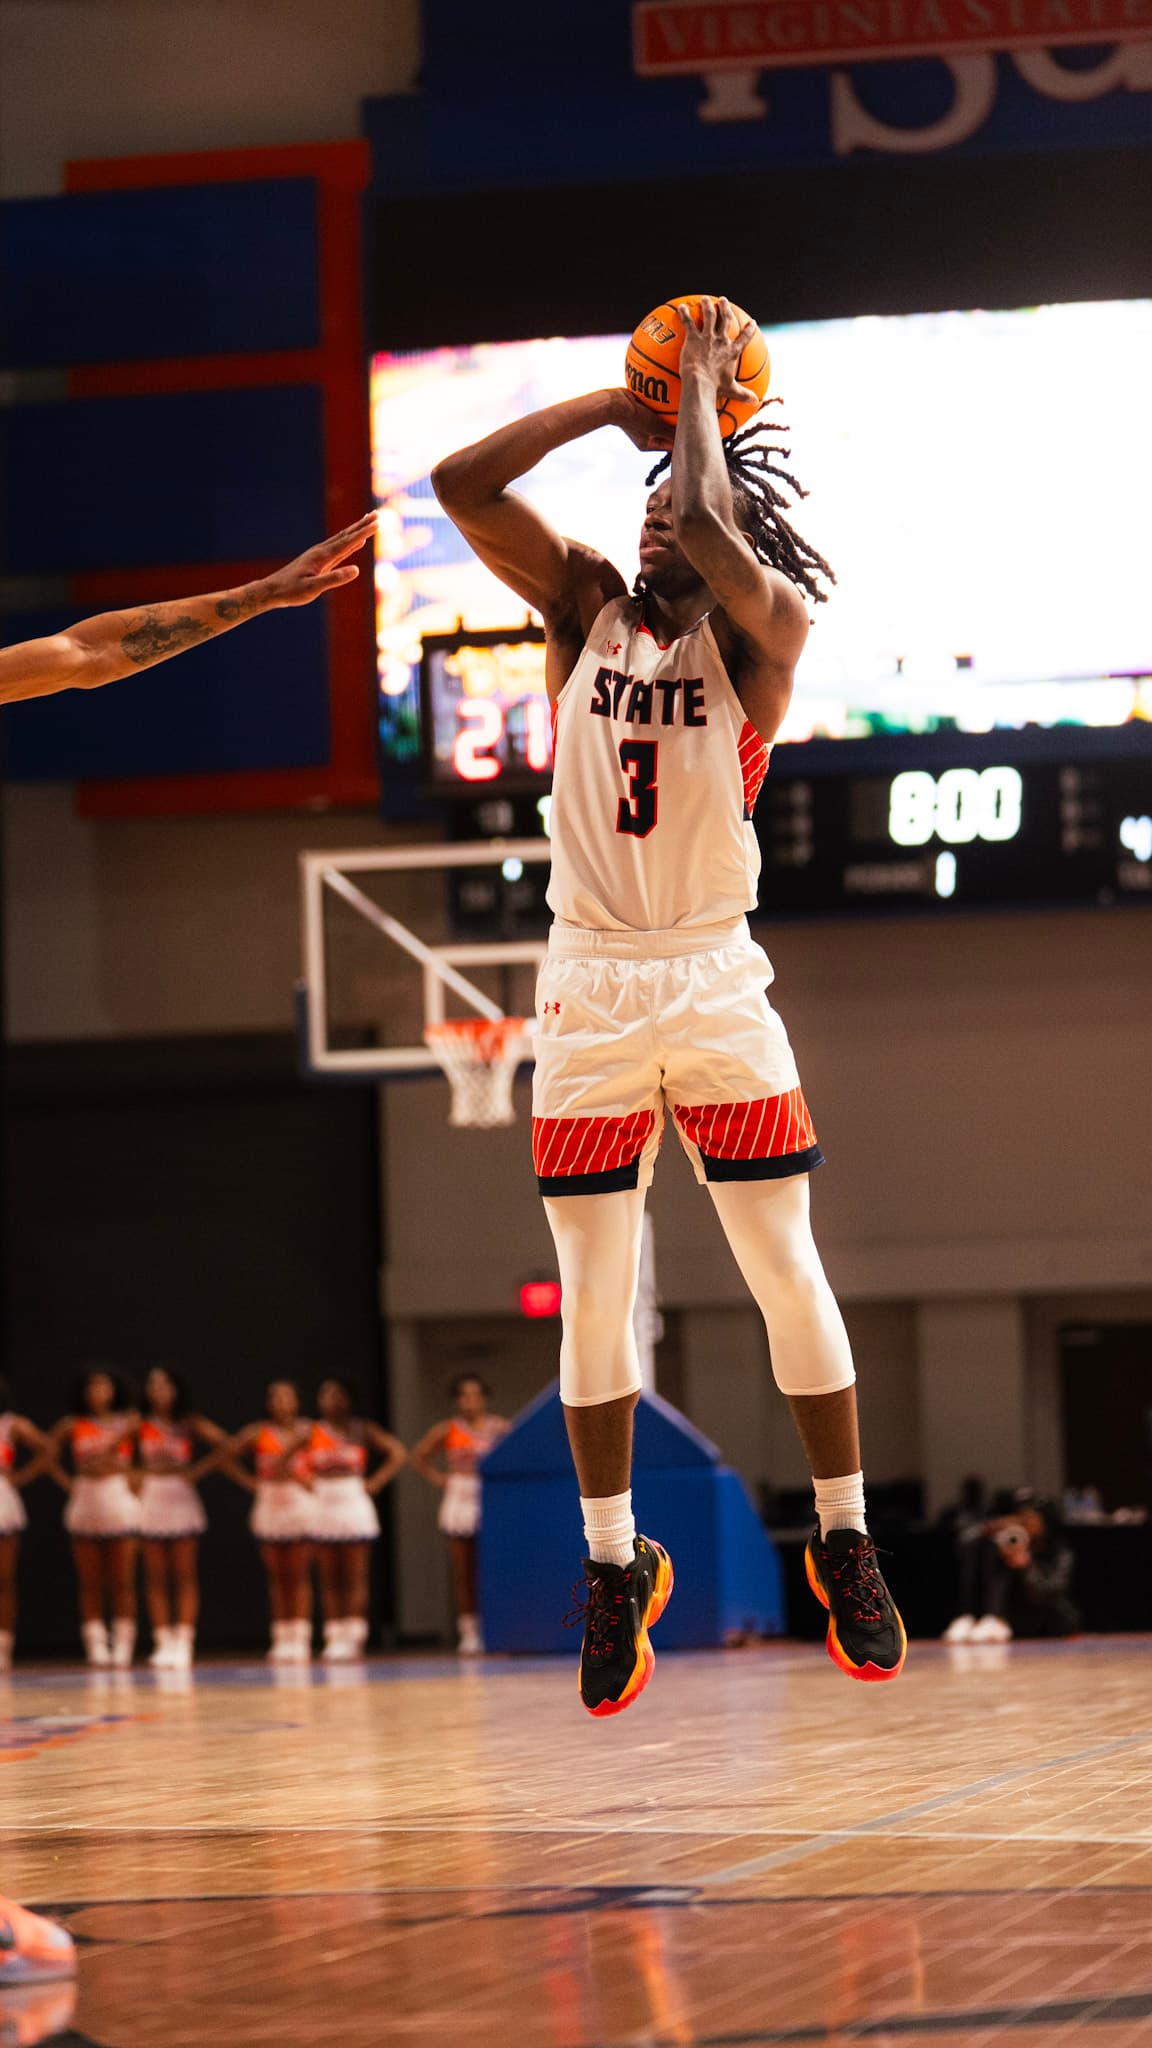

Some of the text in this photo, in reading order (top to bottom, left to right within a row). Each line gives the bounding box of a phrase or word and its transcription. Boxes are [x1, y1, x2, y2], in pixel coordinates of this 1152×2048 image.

[656, 0, 948, 54] VIRGINIA
[590, 667, 708, 727] STATE
[616, 739, 659, 839] 3
